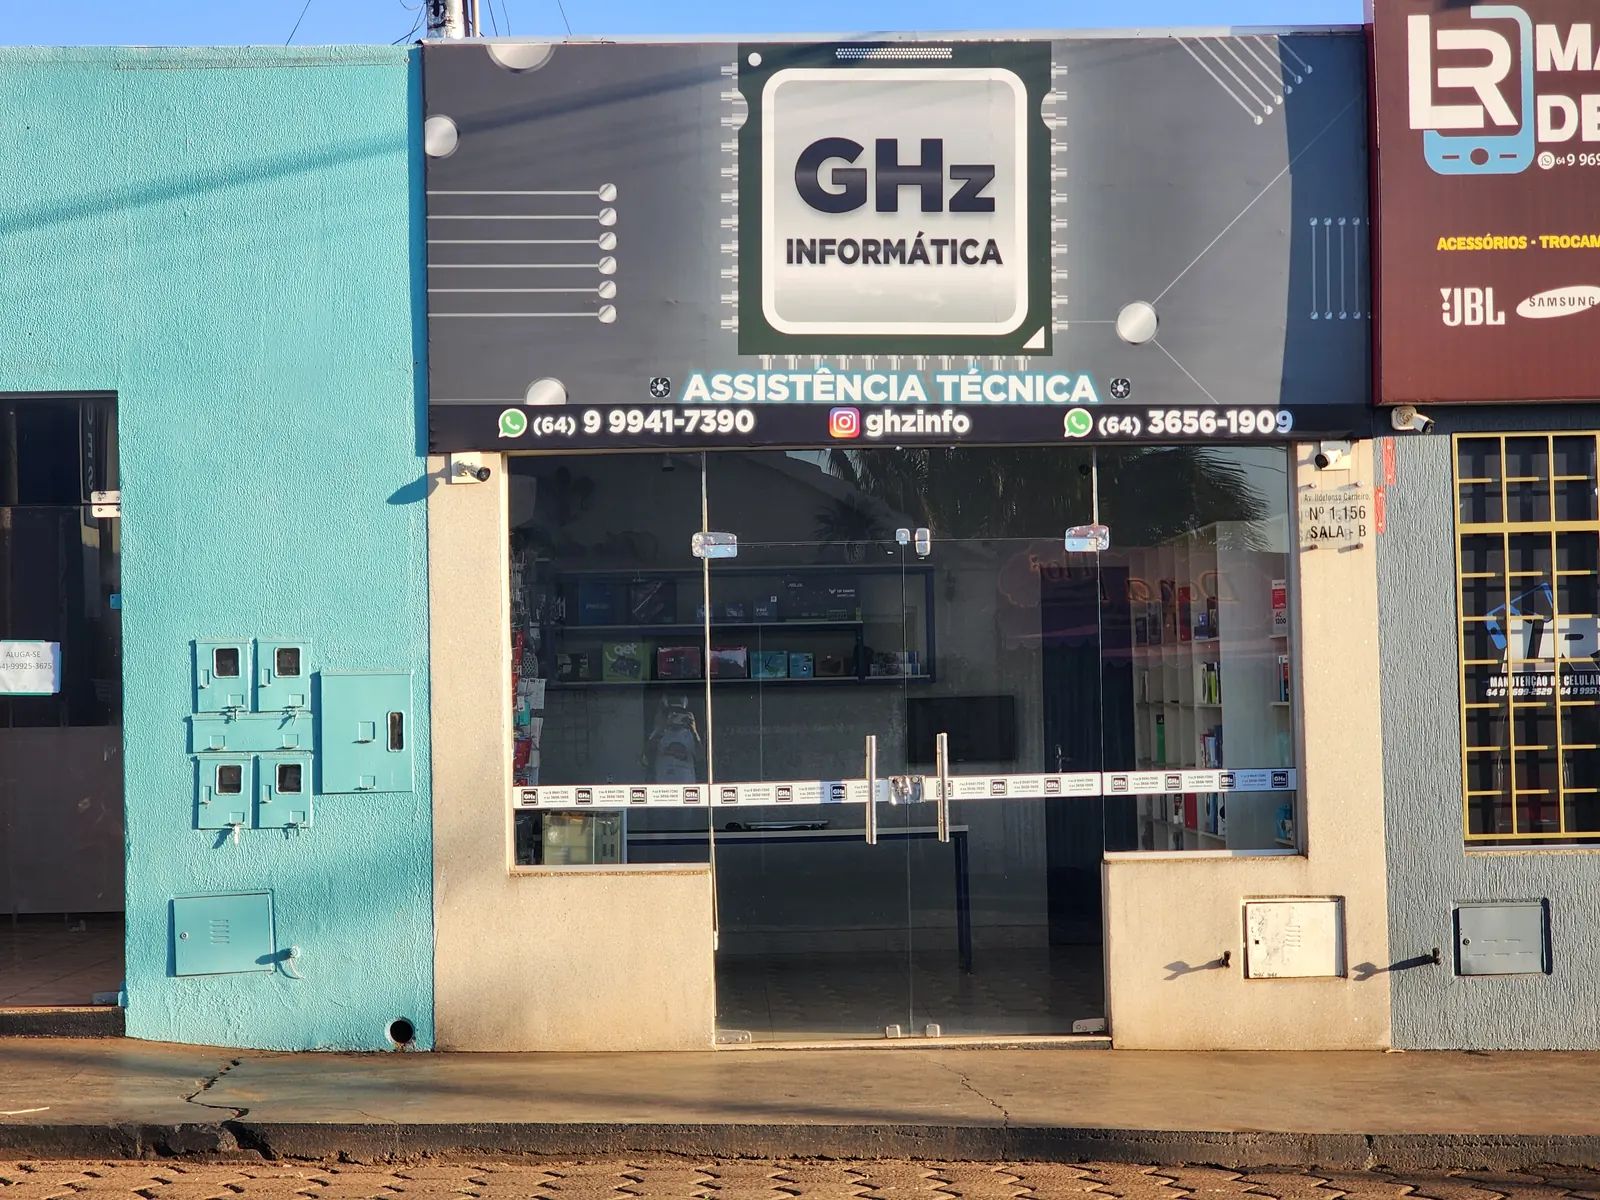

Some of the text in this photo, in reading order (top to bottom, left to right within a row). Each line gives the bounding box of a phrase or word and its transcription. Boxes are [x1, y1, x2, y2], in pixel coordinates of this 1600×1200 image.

[1535, 23, 1600, 72] M
[1408, 14, 1519, 129] LR
[1556, 156, 1566, 165] 64
[1566, 153, 1576, 167] 9
[794, 136, 996, 214] GHz
[786, 231, 1004, 265] INFORMÁTICA
[1437, 233, 1528, 250] ACESSÓRIOS
[1440, 287, 1596, 326] JBL SAMSUNG
[682, 363, 1099, 402] ASSISTÊNCIA TÉCNICA
[533, 409, 755, 436] (64) 9 9941-7390
[865, 409, 971, 437] ghzinfo
[1099, 409, 1294, 437] (64) 3656-1909
[1315, 493, 1342, 503] Ildefonso
[1329, 505, 1367, 520] 1.156
[1310, 525, 1345, 539] SALA
[1358, 524, 1367, 538] B
[0, 661, 52, 671] 4)-99925-3675
[5, 650, 41, 658] ALUGA-SE
[1550, 674, 1561, 687] D
